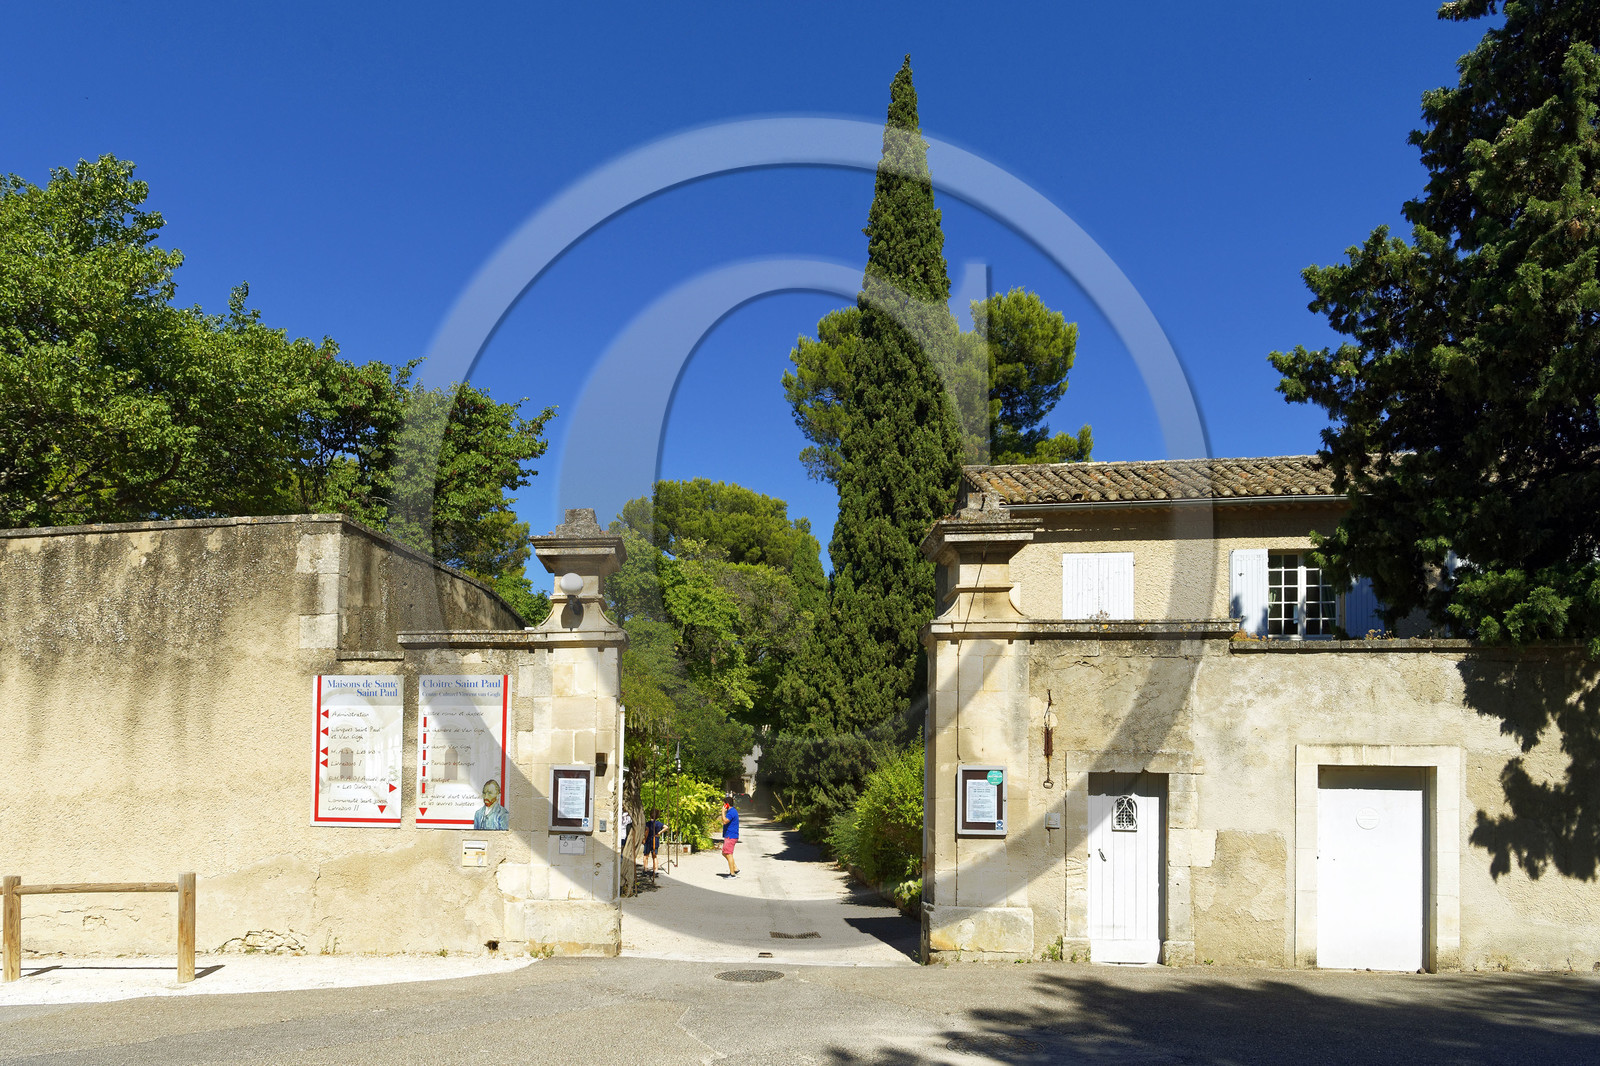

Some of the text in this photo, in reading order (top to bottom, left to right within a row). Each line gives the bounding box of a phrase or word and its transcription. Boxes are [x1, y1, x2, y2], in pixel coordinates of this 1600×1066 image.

[328, 678, 398, 688] Maisons de Santé
[422, 678, 501, 688] Cloître Saint Paul
[357, 688, 398, 697] Saint Paul
